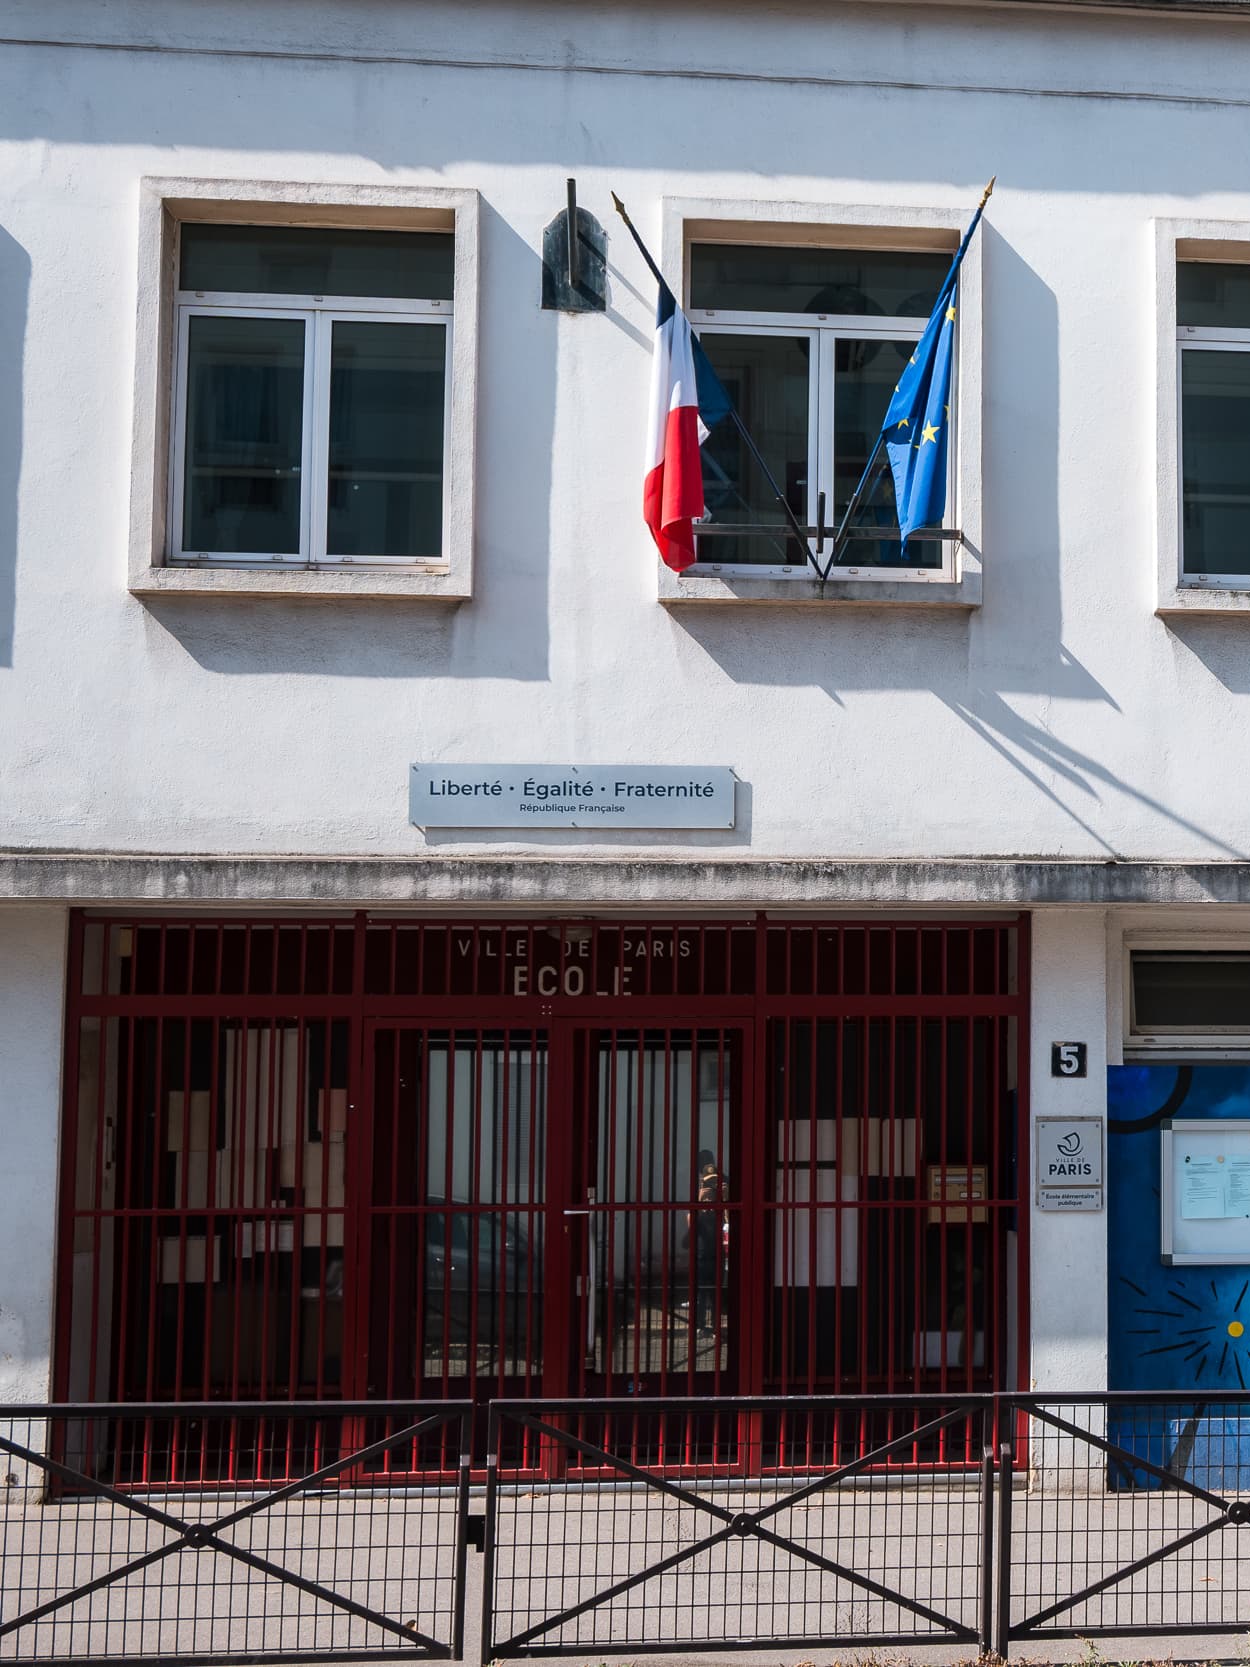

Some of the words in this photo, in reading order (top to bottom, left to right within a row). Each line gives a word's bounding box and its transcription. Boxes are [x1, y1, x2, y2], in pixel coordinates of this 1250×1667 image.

[429, 780, 502, 797] Liberté
[523, 777, 594, 800] Égalité
[614, 781, 715, 798] Fraternité
[519, 803, 576, 815] République
[579, 804, 625, 815] Française
[621, 939, 691, 958] PARIS
[1060, 1046, 1079, 1074] 5
[1049, 1163, 1092, 1176] PARIS
[1061, 1192, 1095, 1200] élémentaire
[1057, 1199, 1083, 1207] publique
